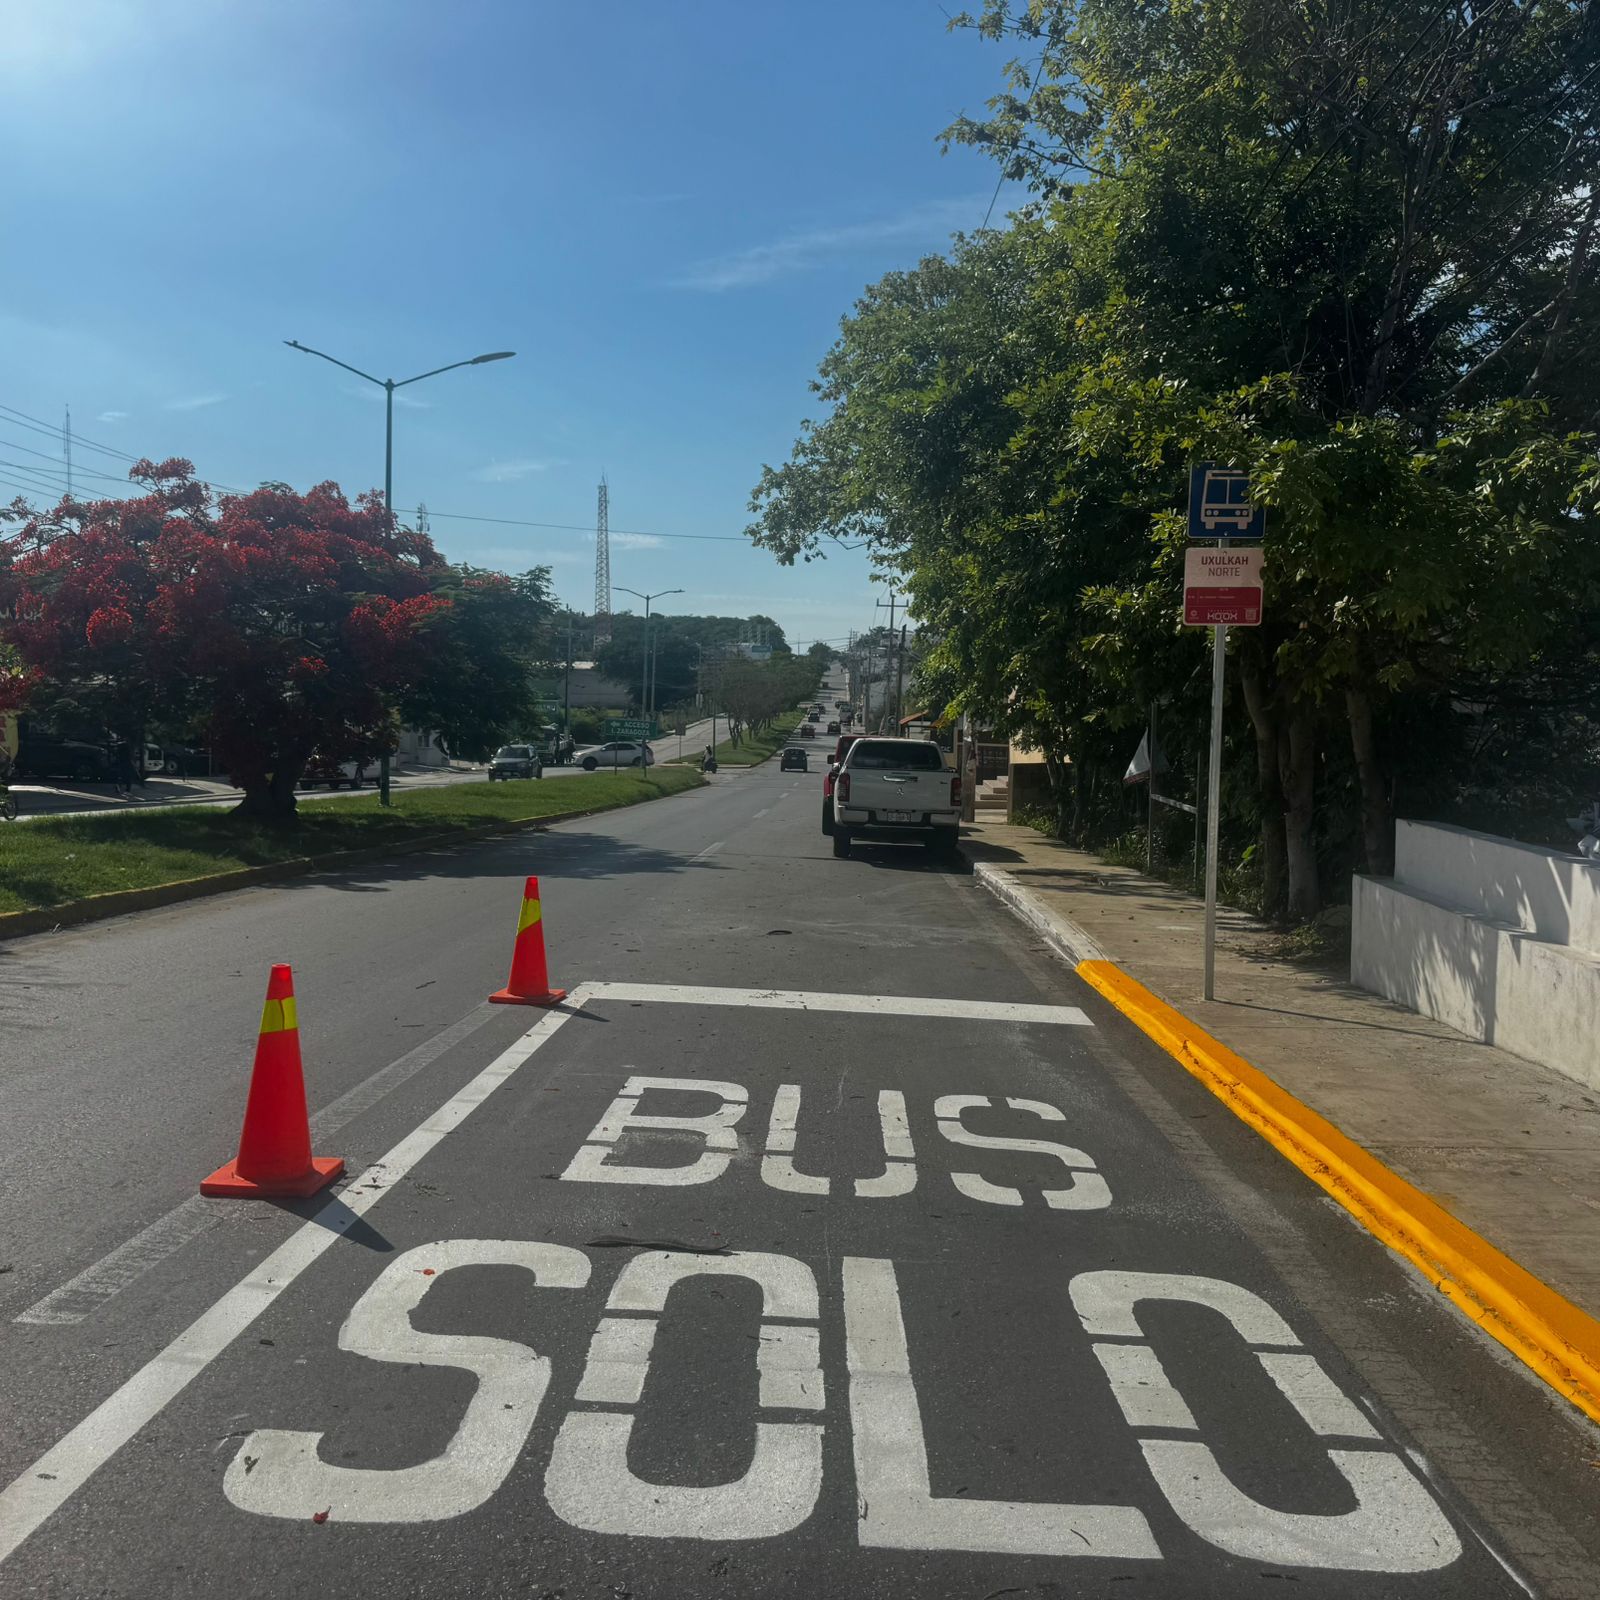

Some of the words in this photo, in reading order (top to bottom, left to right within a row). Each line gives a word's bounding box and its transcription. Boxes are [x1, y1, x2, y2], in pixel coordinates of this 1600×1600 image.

[1201, 556, 1248, 565] UXULKAH
[1208, 567, 1240, 576] NORTE
[624, 721, 650, 729] ACCESO
[616, 728, 650, 736] ZARAGOZA
[560, 1076, 1112, 1210] BUS
[222, 1239, 1463, 1573] SOLO
